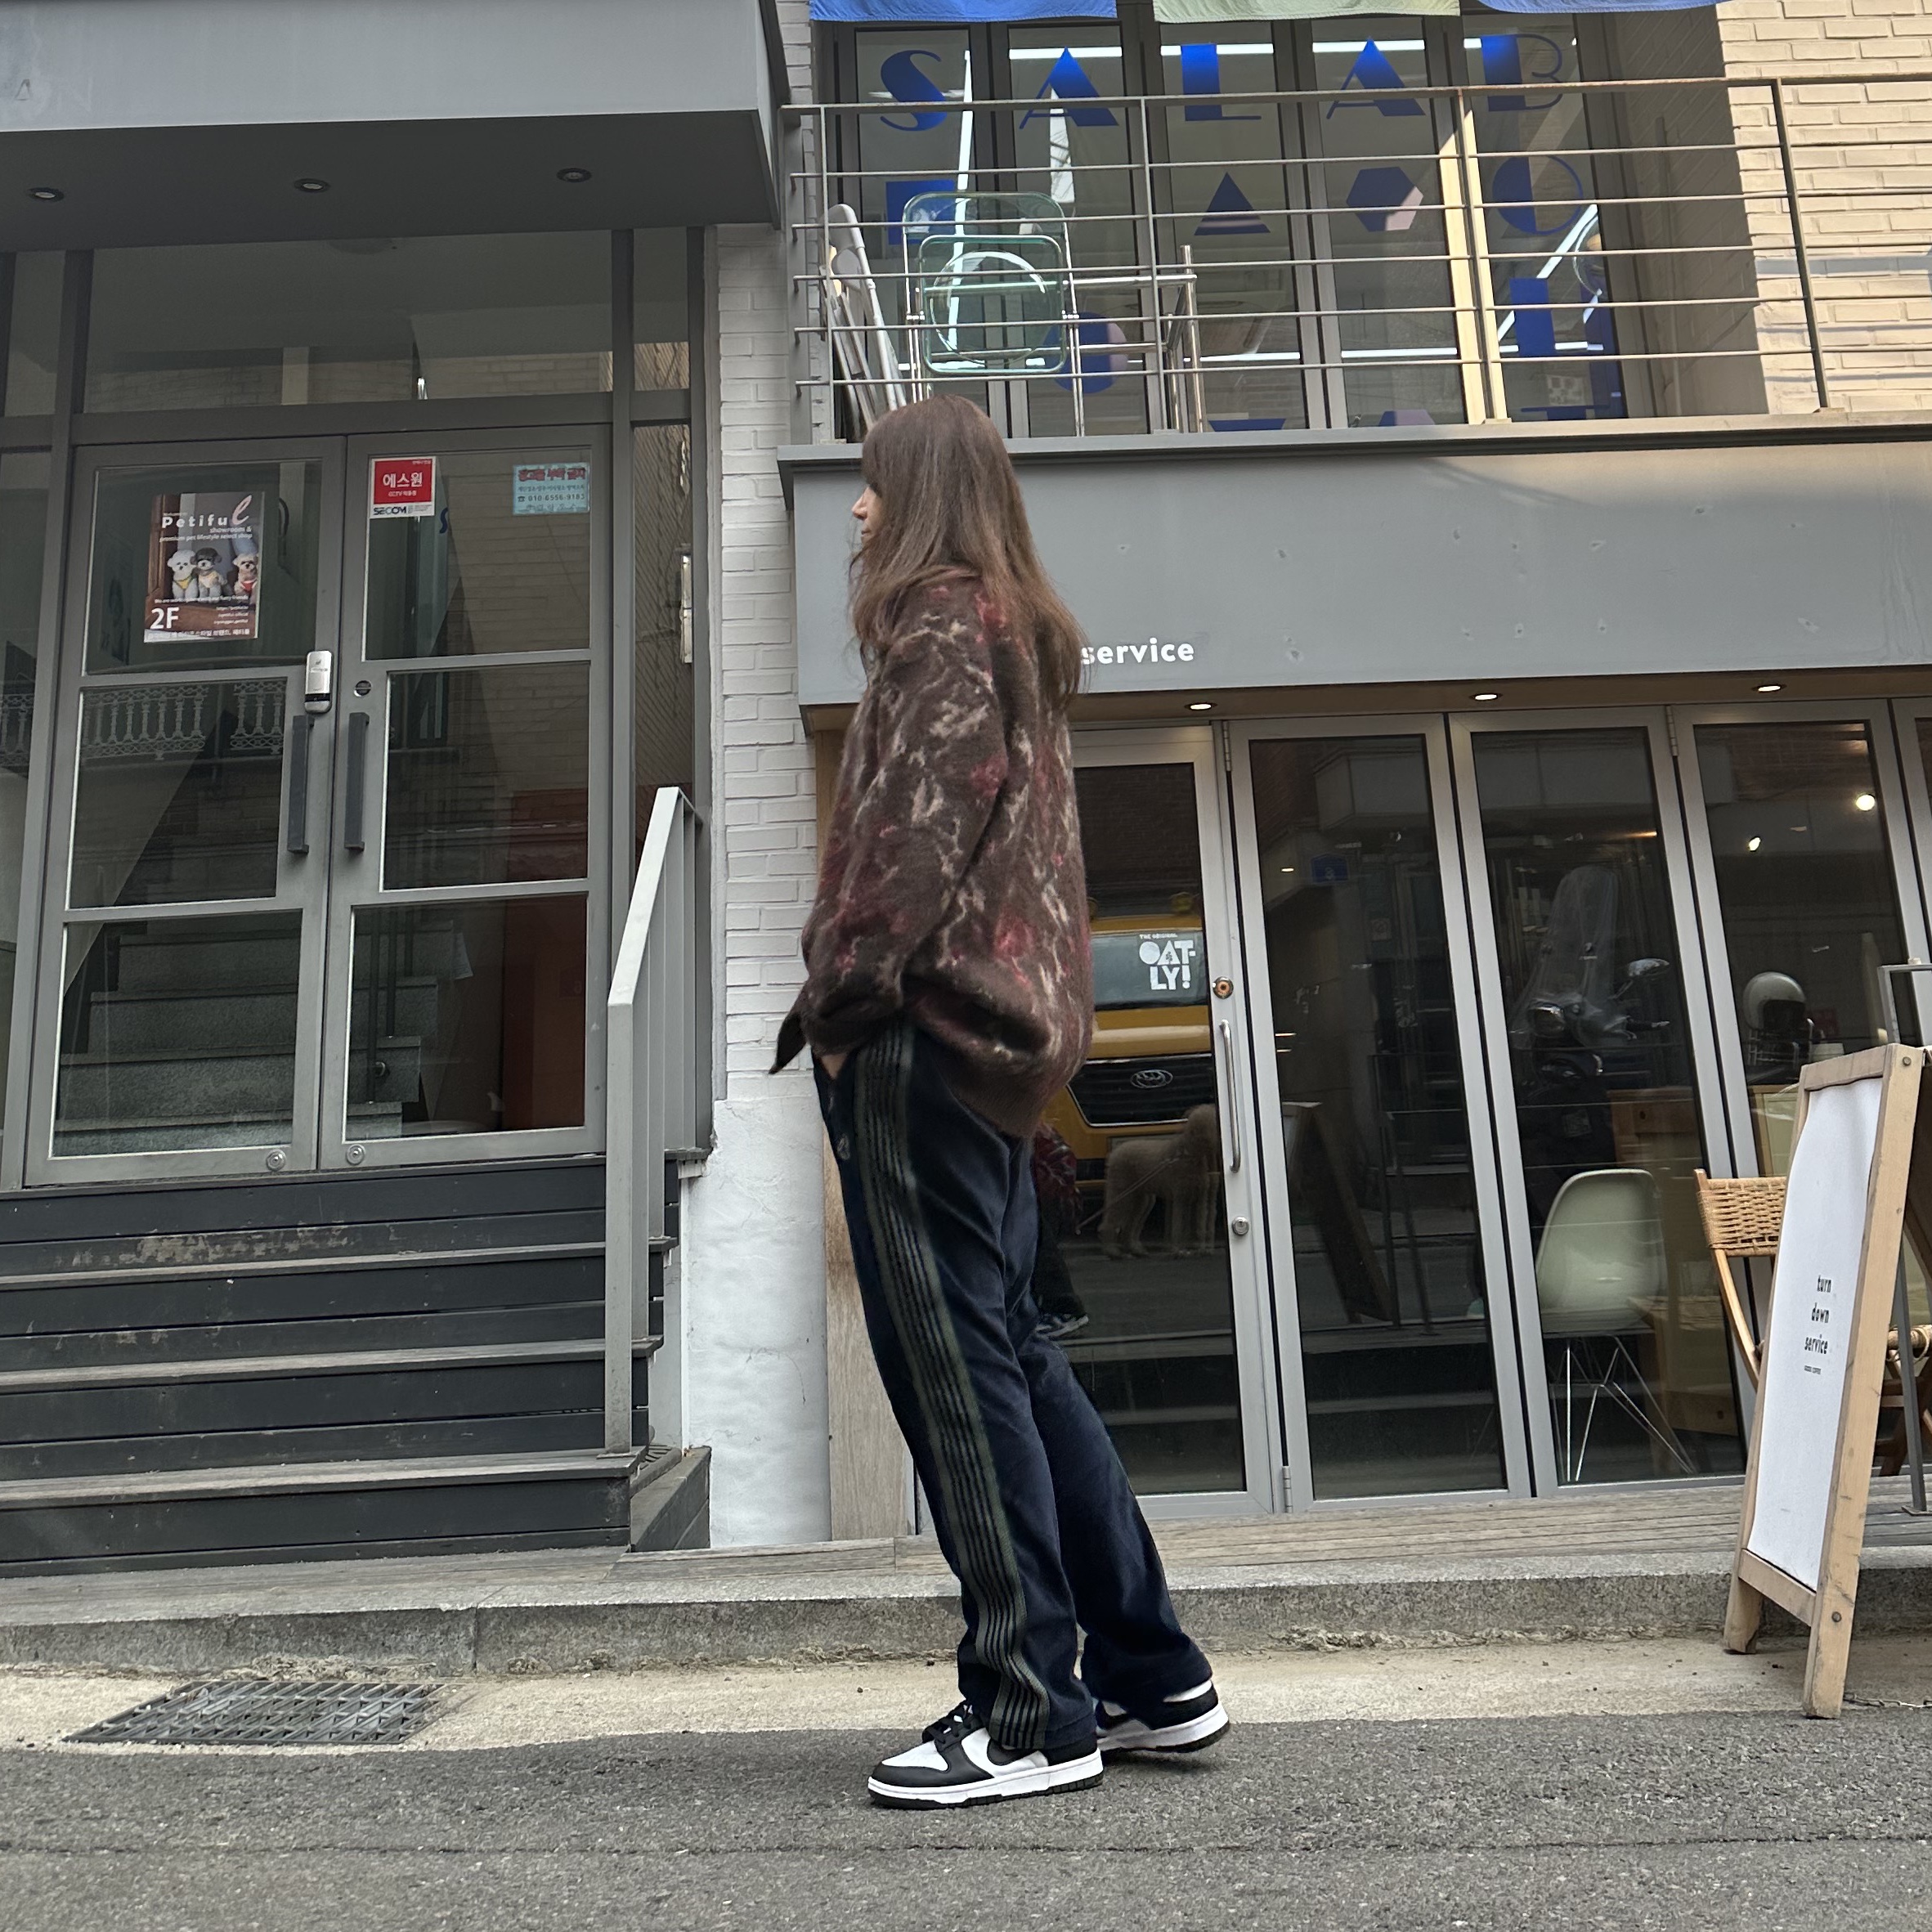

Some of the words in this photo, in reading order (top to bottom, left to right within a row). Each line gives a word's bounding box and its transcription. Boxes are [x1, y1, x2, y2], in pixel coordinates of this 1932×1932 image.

[382, 472, 423, 488] 에스원
[162, 495, 253, 529] Petiful
[373, 506, 407, 515] SECOM
[150, 607, 180, 630] 2F
[1081, 637, 1195, 665] service
[1150, 965, 1191, 991] LY!
[1817, 1275, 1832, 1293] turn
[1811, 1302, 1830, 1324] down
[1804, 1334, 1828, 1355] service
